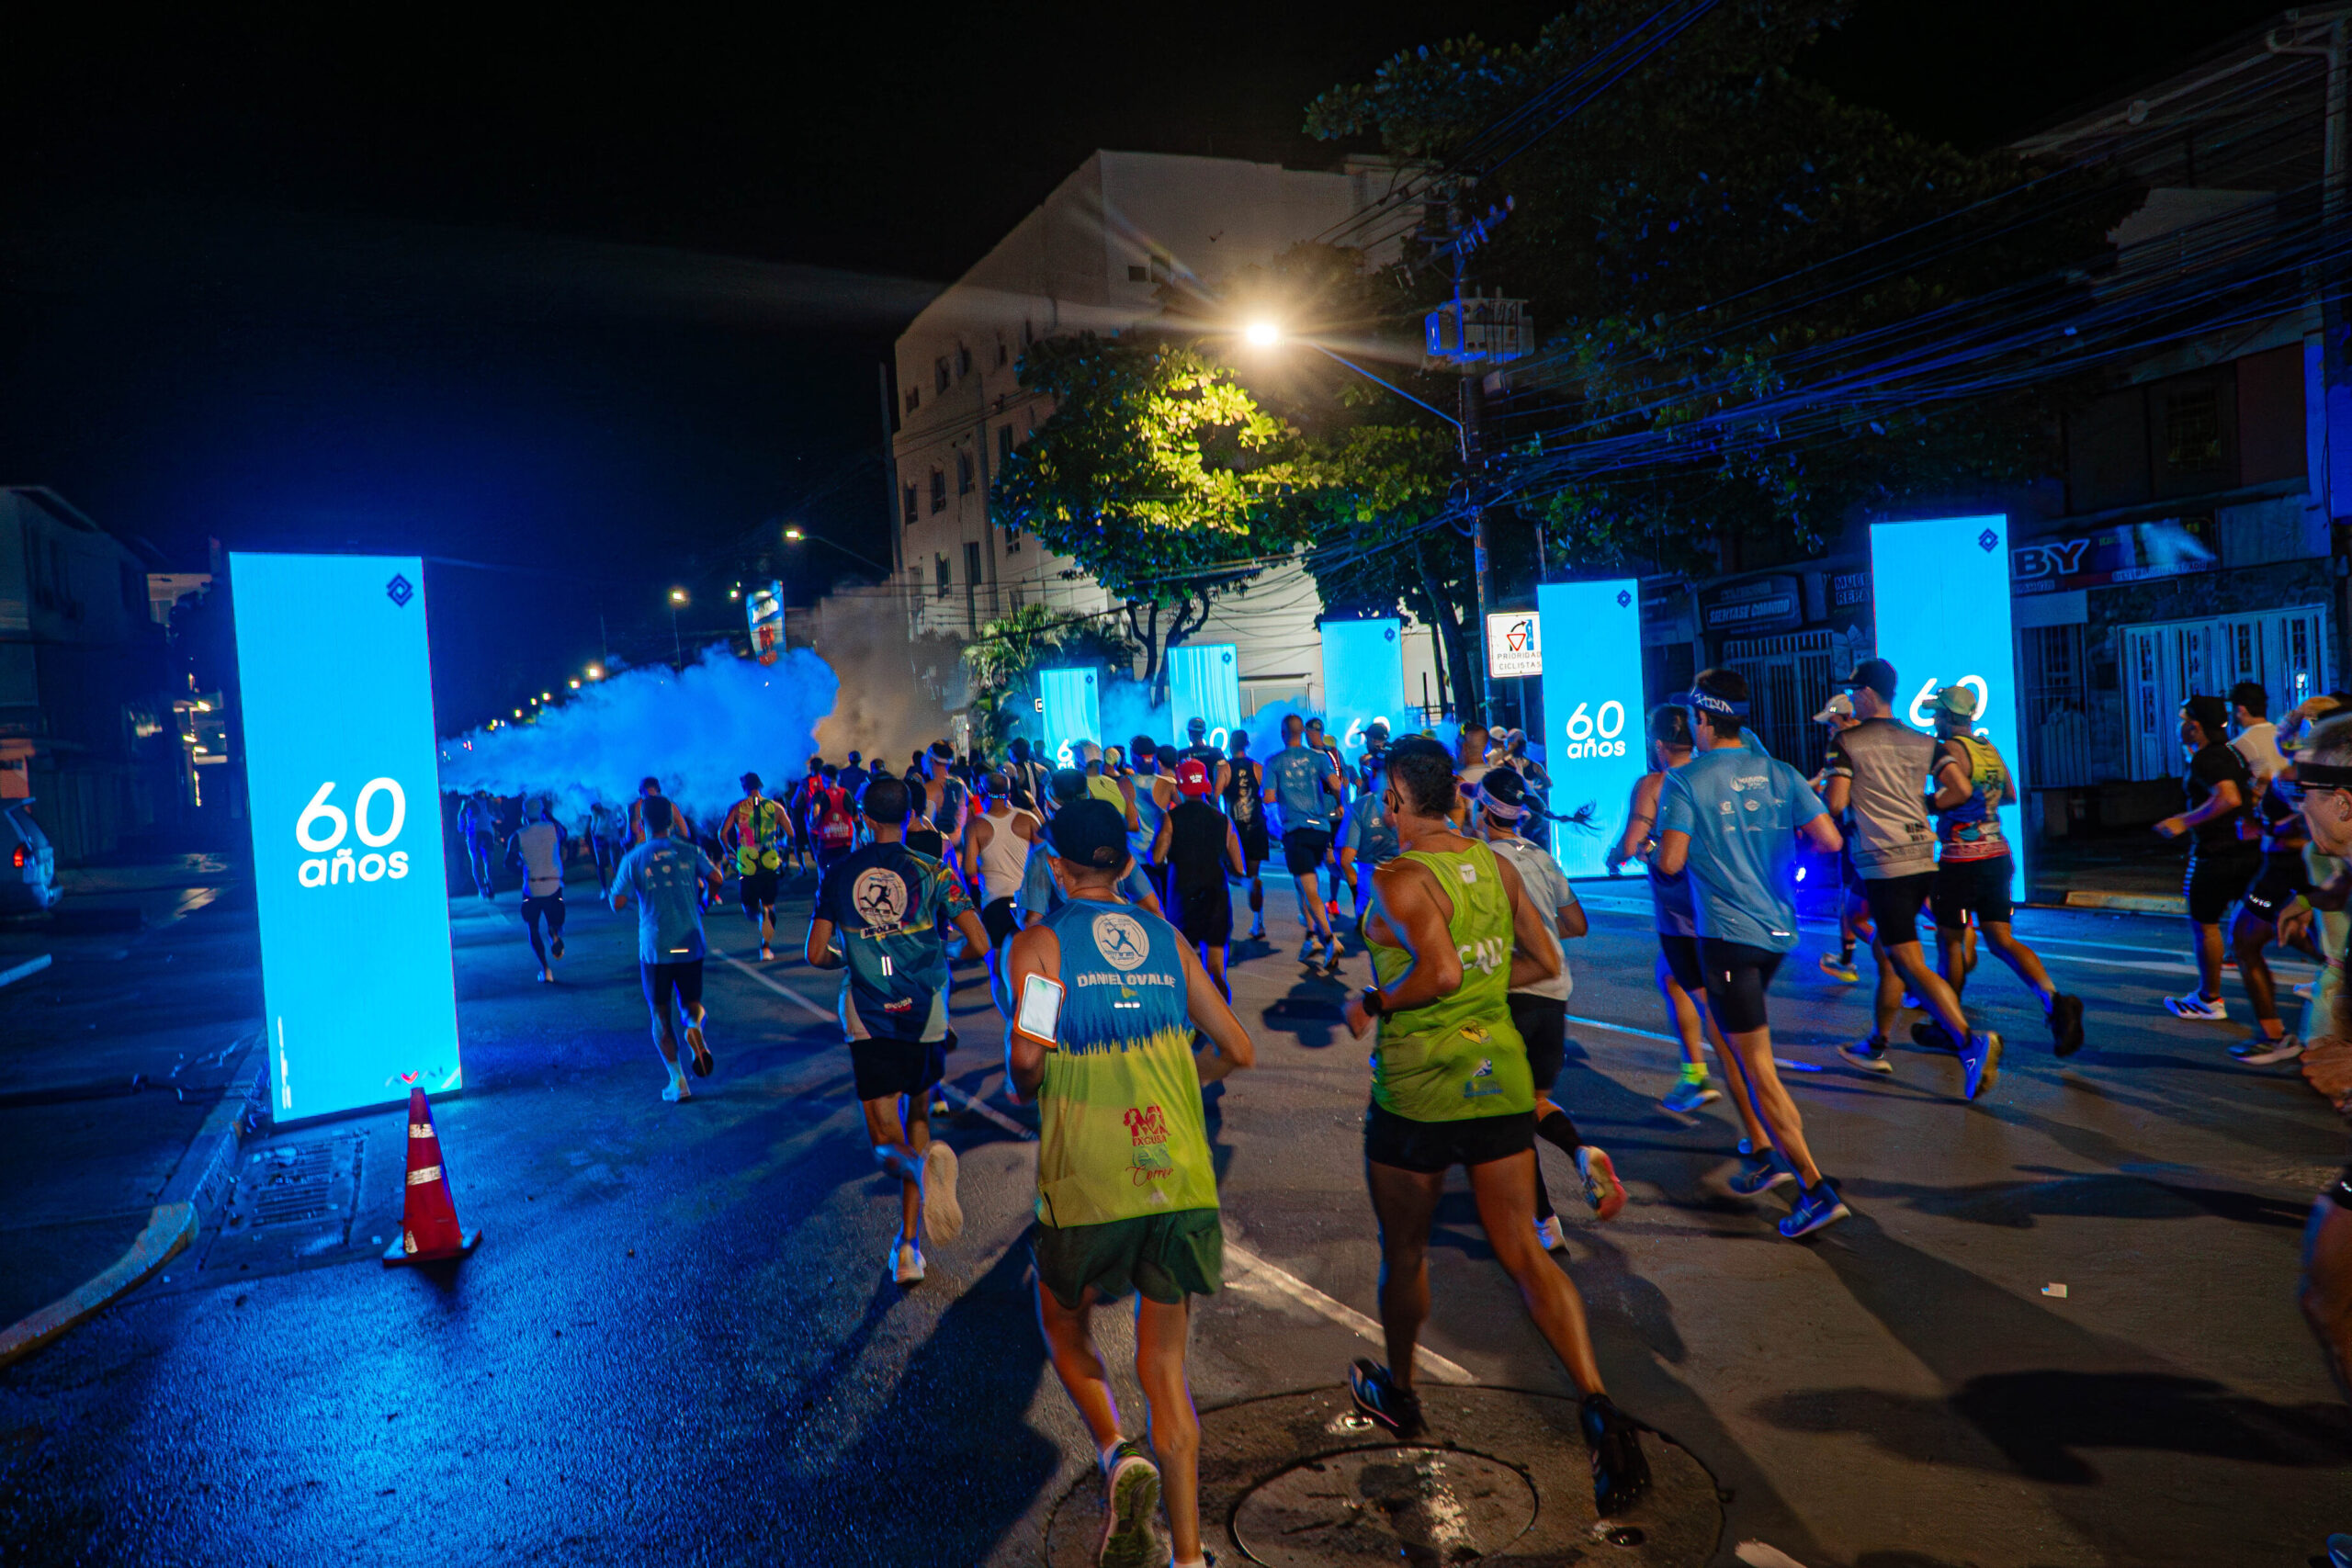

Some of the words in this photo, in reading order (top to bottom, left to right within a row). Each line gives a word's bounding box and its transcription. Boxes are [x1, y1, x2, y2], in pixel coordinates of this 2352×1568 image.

[1497, 651, 1542, 660] PRIORIDAD
[1498, 660, 1542, 671] CICLISTAS
[1566, 700, 1625, 740] 60
[1566, 738, 1626, 759] años
[296, 777, 406, 852] 60
[298, 848, 409, 888] años
[1077, 971, 1125, 987] DANIEL
